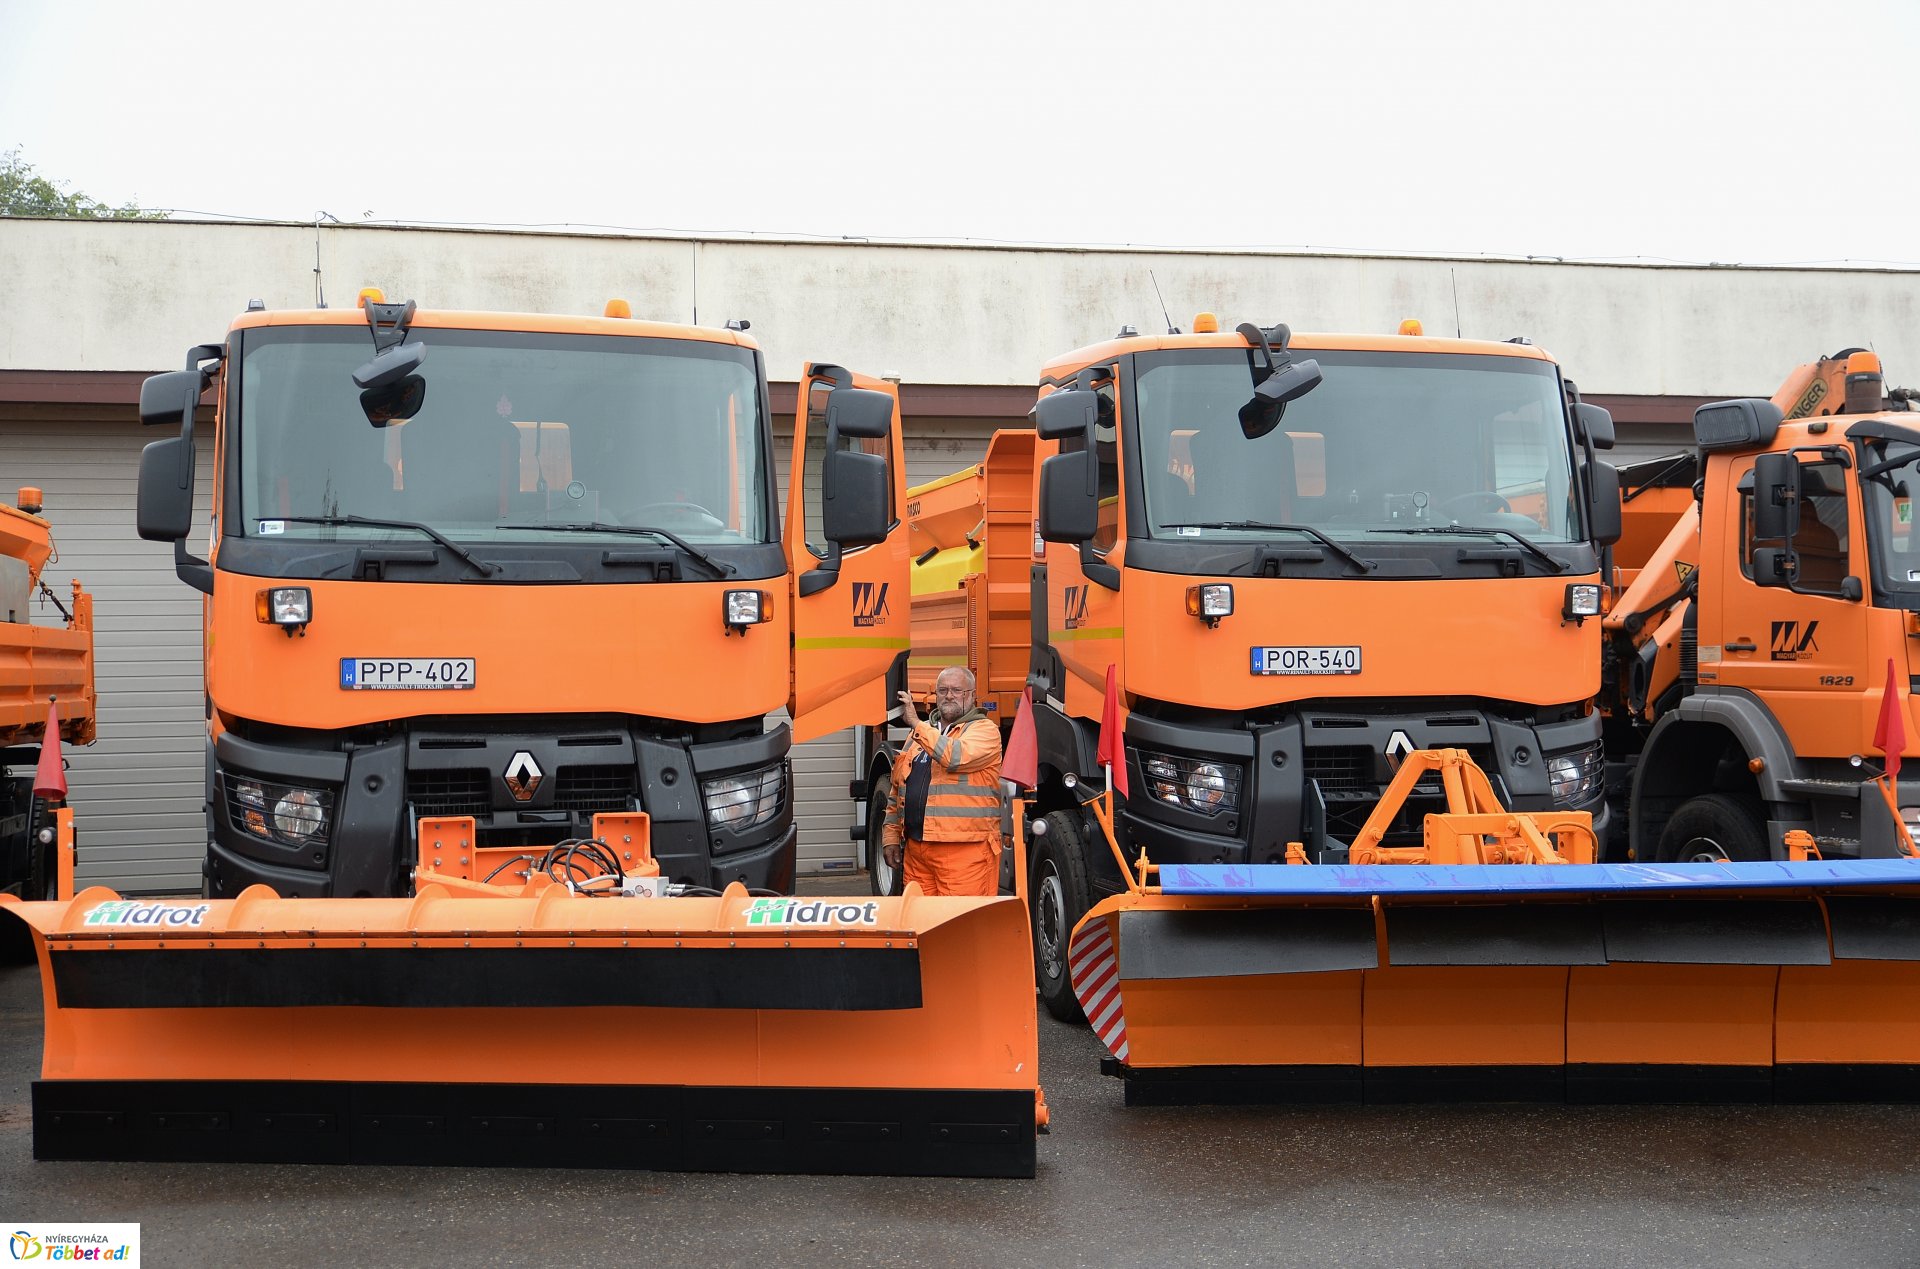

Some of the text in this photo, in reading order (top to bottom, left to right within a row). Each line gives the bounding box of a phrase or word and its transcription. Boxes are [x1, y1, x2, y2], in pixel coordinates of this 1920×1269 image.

[1788, 384, 1825, 420] NGER
[1255, 650, 1355, 669] H POR-540
[345, 662, 469, 683] H PPP-402
[1819, 675, 1854, 687] 1829
[88, 901, 208, 925] Hidrot
[749, 899, 877, 924] Hidrot
